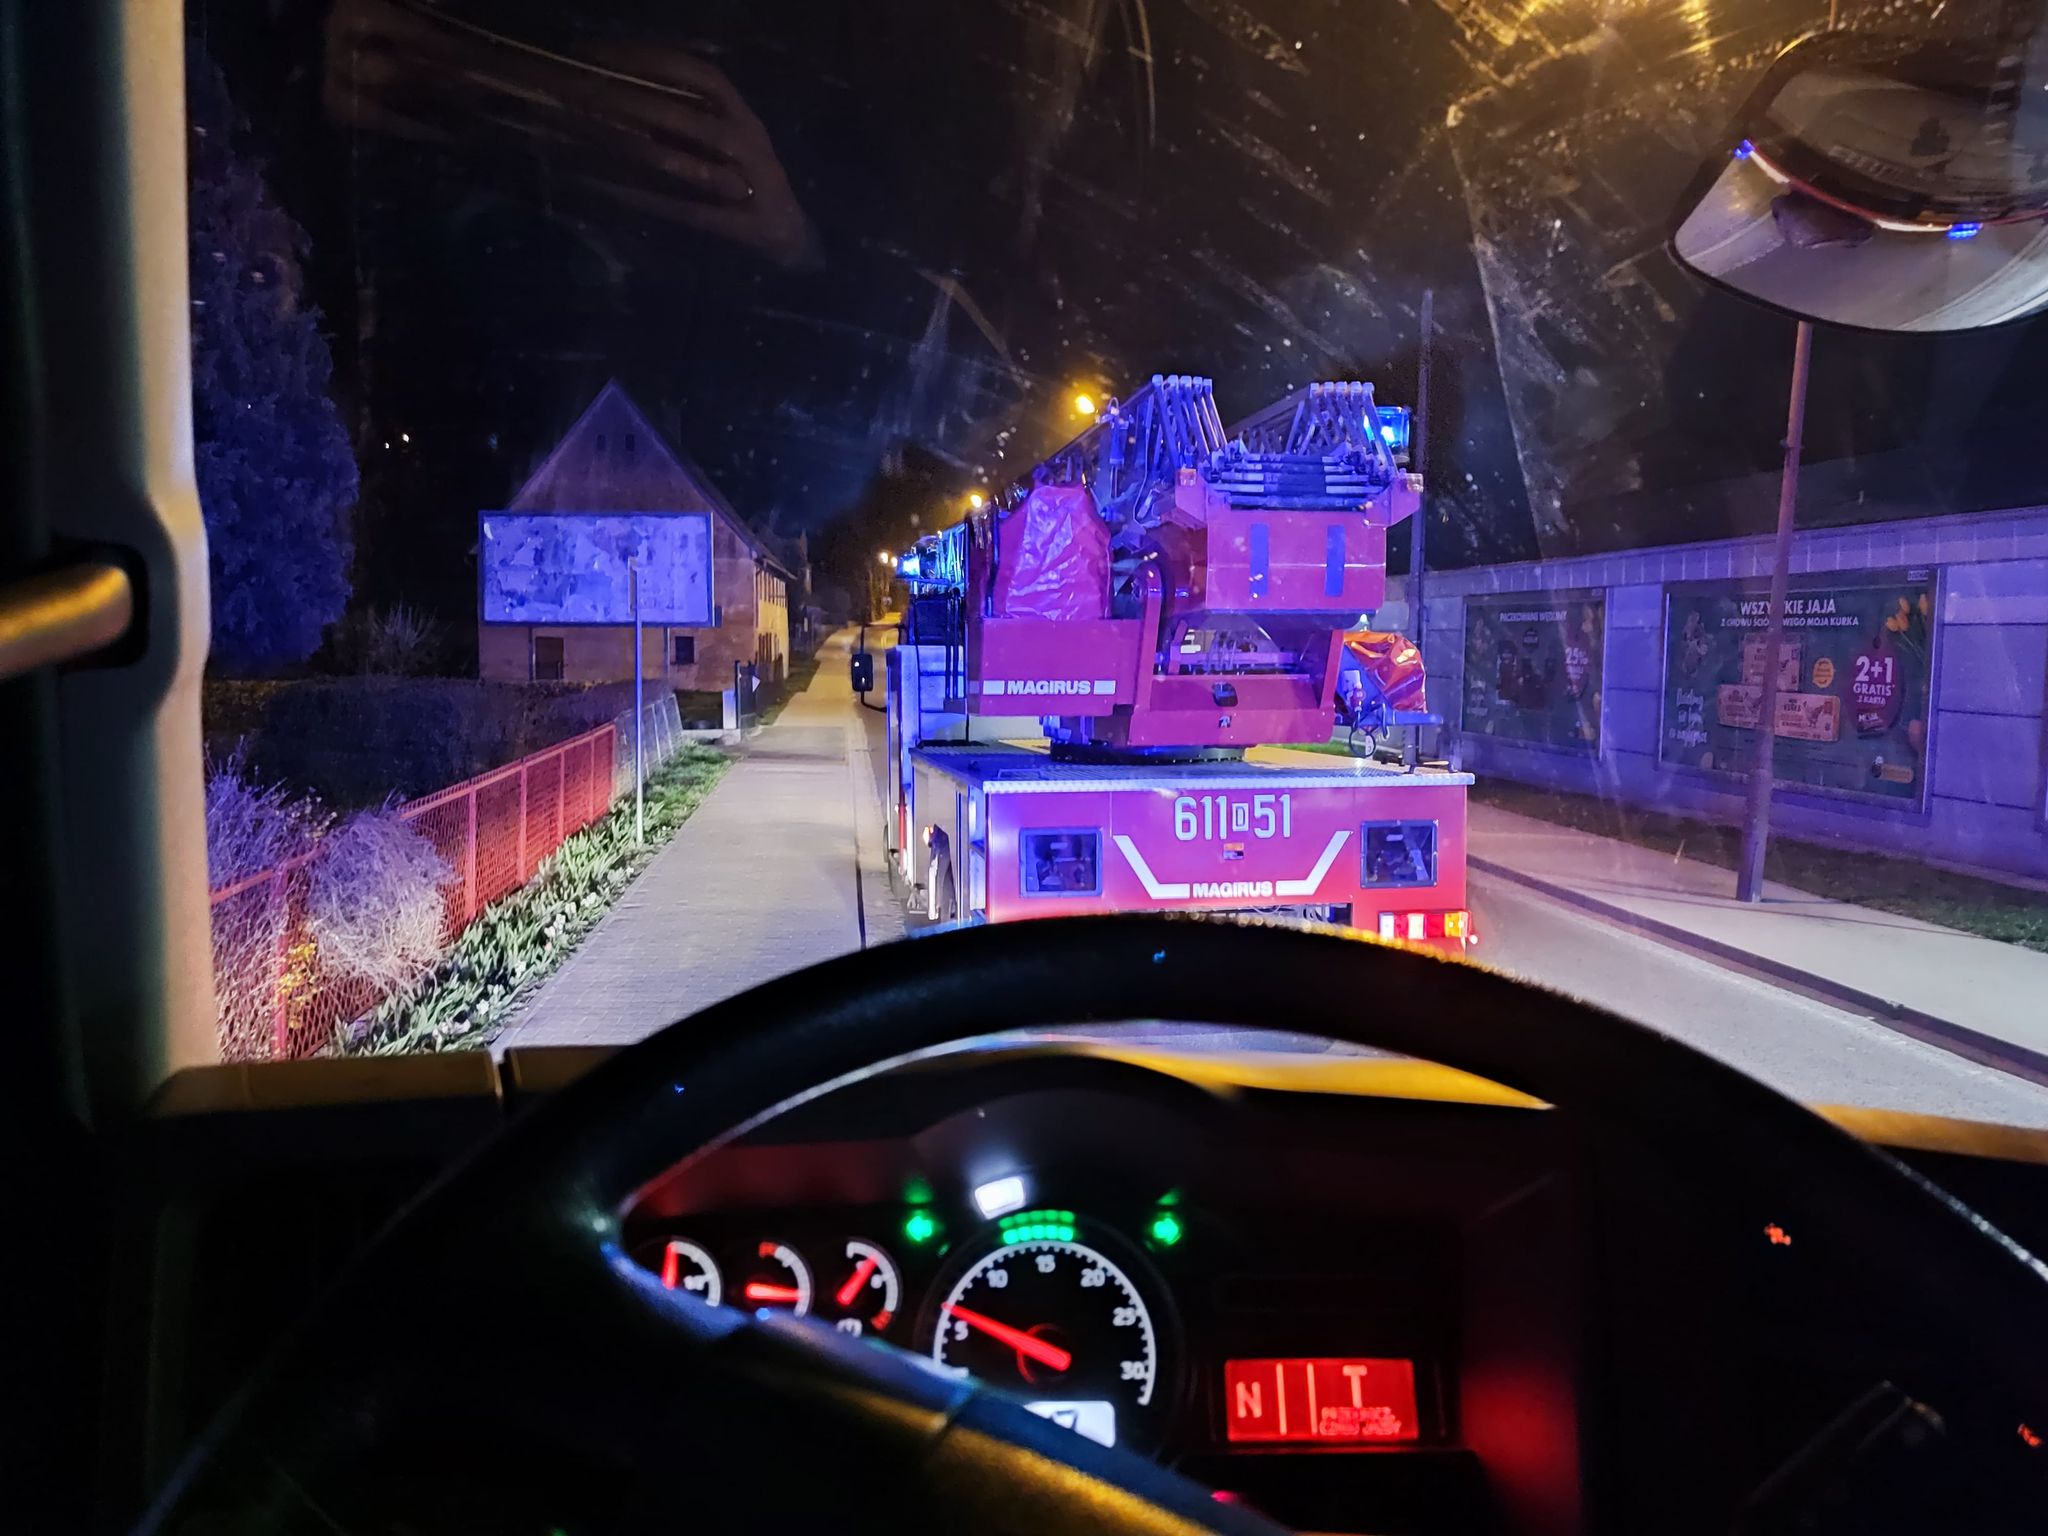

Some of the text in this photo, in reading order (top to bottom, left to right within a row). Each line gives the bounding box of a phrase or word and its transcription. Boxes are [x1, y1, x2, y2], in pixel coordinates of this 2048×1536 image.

[1740, 598, 1836, 615] WSZYKIE JAJA
[1807, 616, 1829, 626] MOJA
[1830, 615, 1859, 626] KURKA
[1856, 655, 1893, 683] 2+1
[1007, 680, 1091, 695] MAGIRUS
[1193, 881, 1273, 898] MAGIRUS
[1035, 1254, 1056, 1273] 15
[987, 1269, 1008, 1288] 10
[1081, 1268, 1105, 1287] 20
[1113, 1307, 1136, 1326] 25
[955, 1320, 969, 1341] 5
[1120, 1361, 1146, 1380] 30
[1342, 1365, 1367, 1408] T
[1236, 1382, 1262, 1418] N
